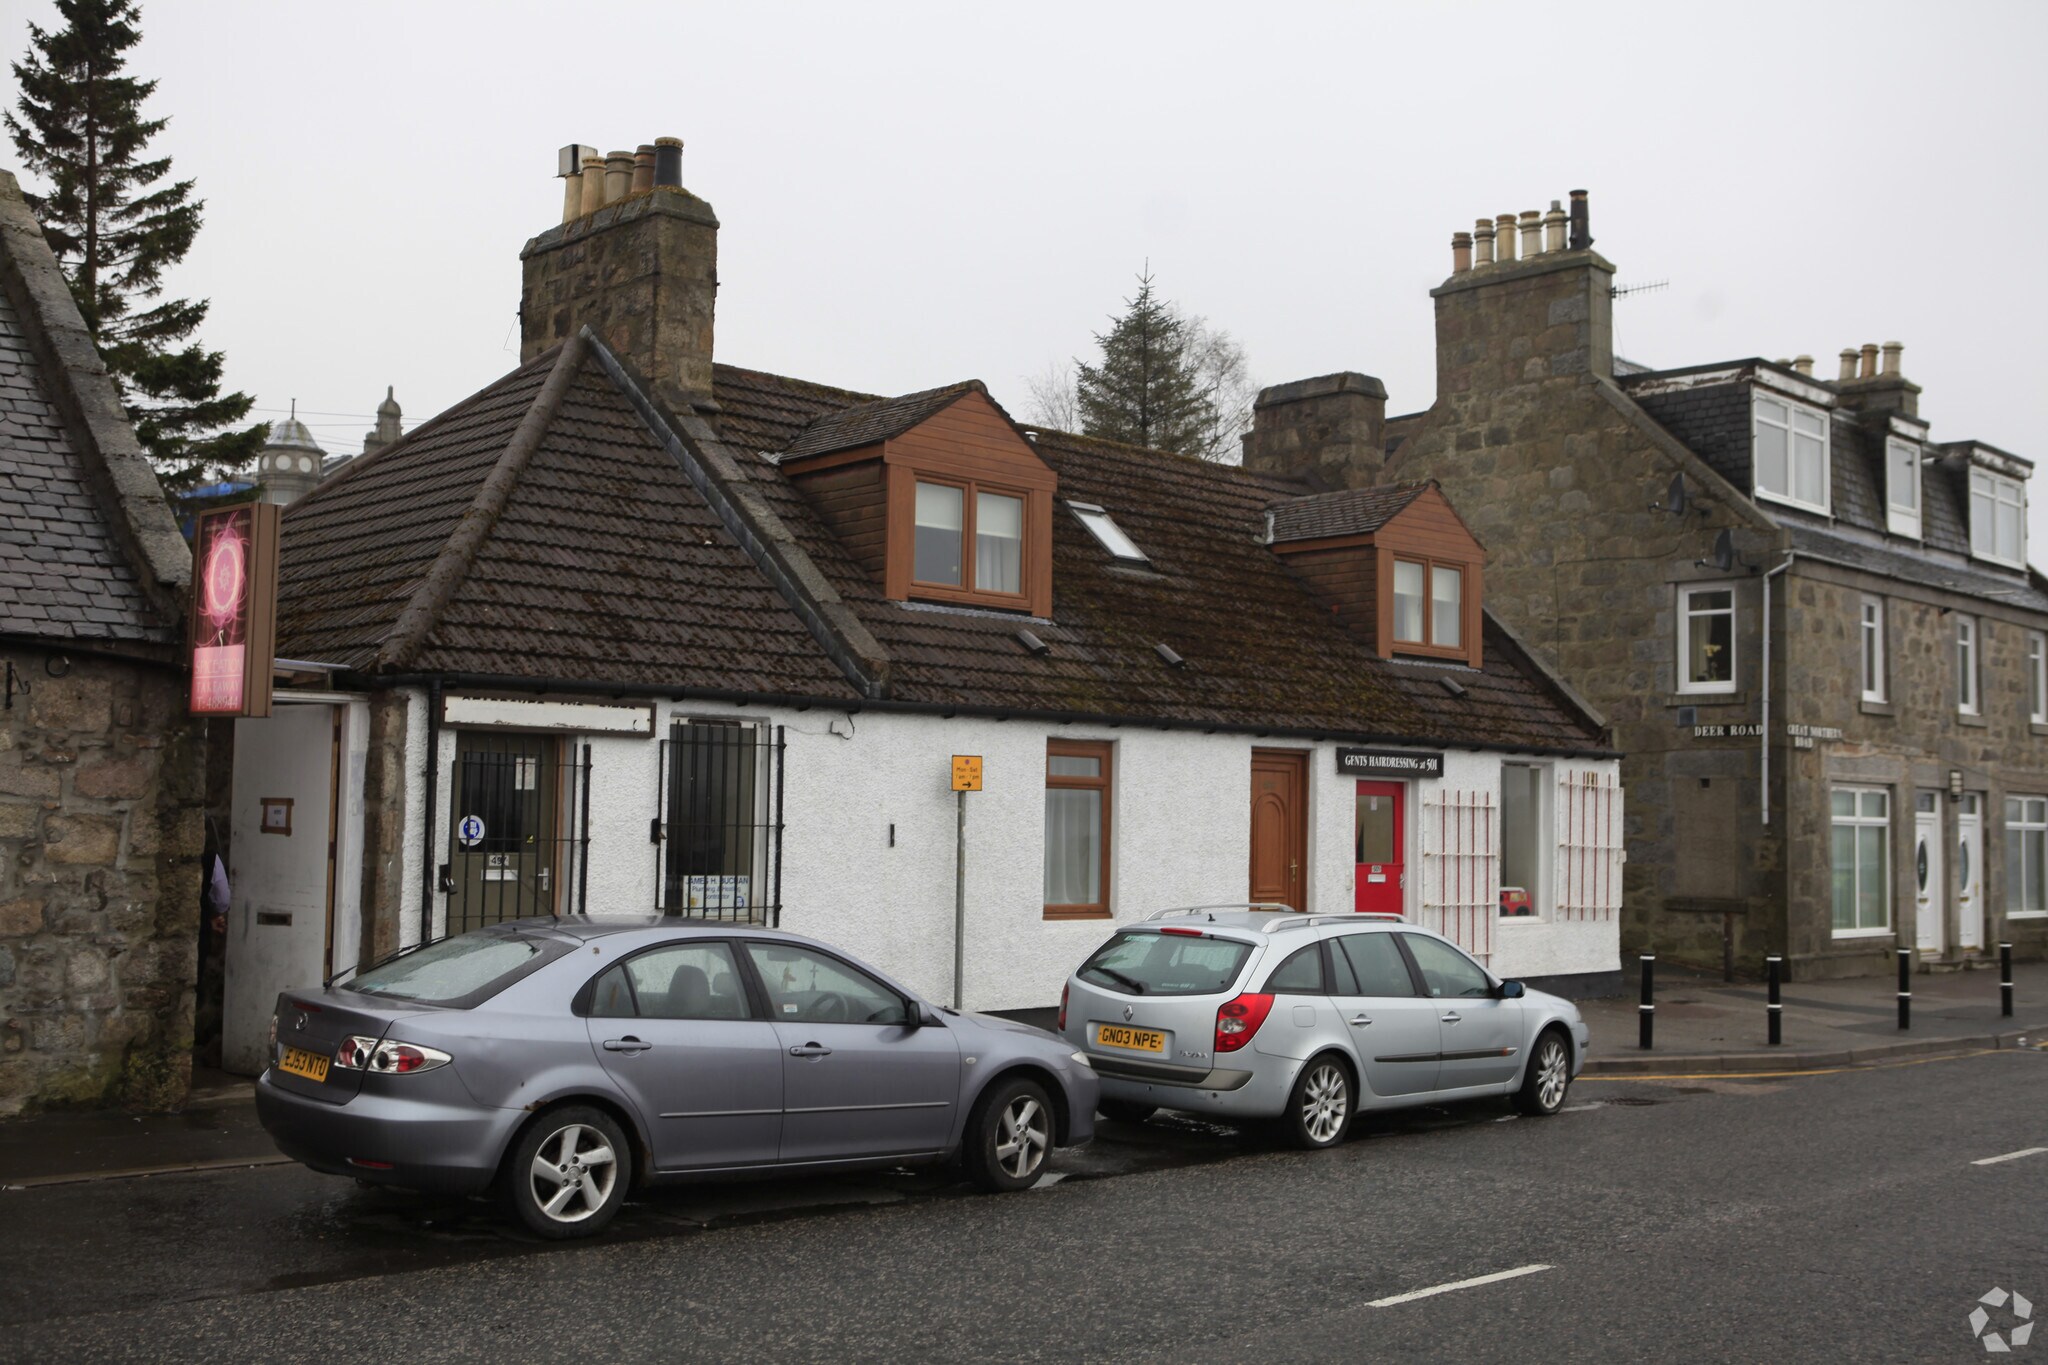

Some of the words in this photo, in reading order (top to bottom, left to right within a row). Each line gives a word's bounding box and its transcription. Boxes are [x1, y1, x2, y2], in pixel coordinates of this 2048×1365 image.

[196, 680, 239, 693] TAKEAWAY
[1694, 725, 1725, 737] DEER
[1729, 724, 1763, 736] ROAD
[1787, 724, 1809, 736] GREAT
[1794, 736, 1814, 748] ROAD
[1344, 754, 1368, 767] GENTS
[1369, 756, 1418, 769] HAIRDRESSING
[1419, 761, 1426, 769] at
[1426, 758, 1438, 771] 501
[1101, 1027, 1131, 1044] GN03
[1133, 1031, 1159, 1049] NPE
[284, 1048, 308, 1071] EJ53
[306, 1054, 328, 1076] NTO
